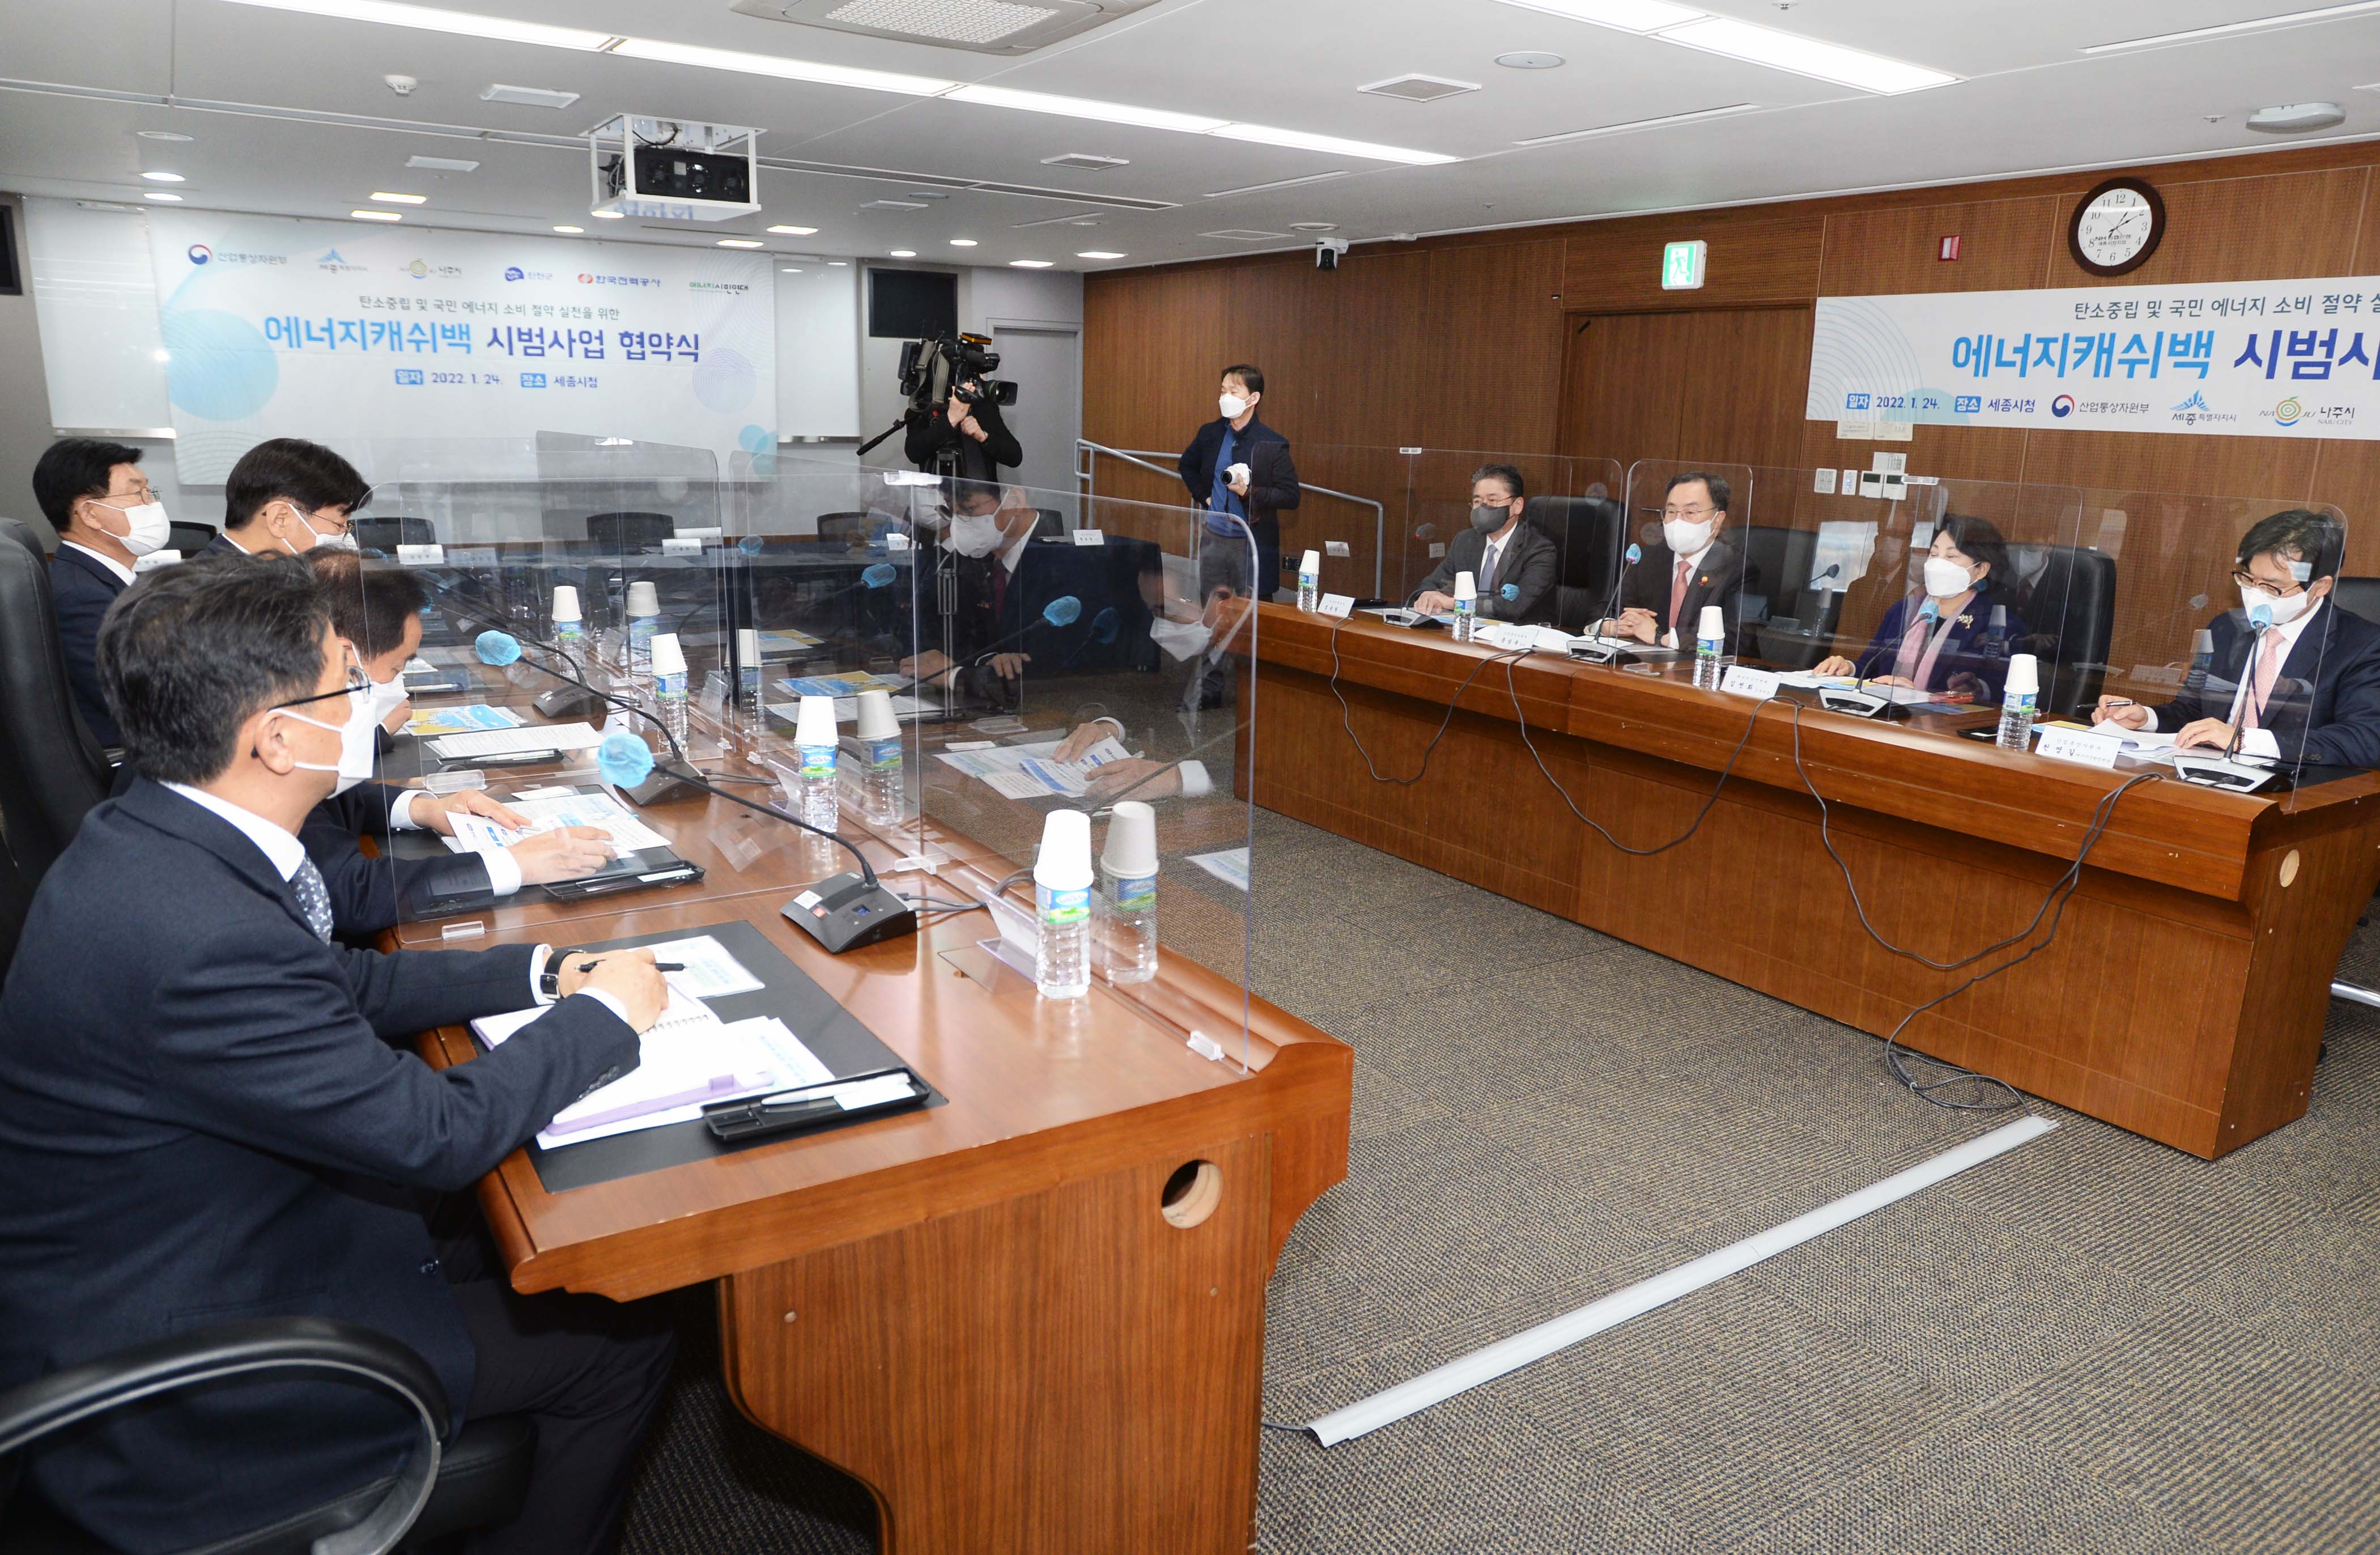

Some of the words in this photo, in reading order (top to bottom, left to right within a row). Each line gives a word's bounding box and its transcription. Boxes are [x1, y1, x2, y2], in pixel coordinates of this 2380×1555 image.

[2102, 199, 2110, 207] 11
[2115, 194, 2126, 203] 12
[2131, 197, 2136, 207] 1
[2086, 225, 2092, 235] 9
[2141, 222, 2148, 231] 3
[2088, 238, 2095, 248] 8
[2135, 236, 2141, 245] 4
[2096, 249, 2102, 258] 7
[2110, 252, 2116, 262] 6
[2124, 248, 2131, 257] 5
[596, 275, 661, 287] 한국전력공사
[359, 296, 410, 311] 탄소중립
[416, 298, 428, 311] 및
[434, 299, 457, 313] 국민
[462, 301, 497, 314] 에너지
[503, 303, 526, 316] 소비
[532, 304, 554, 317] 절약
[559, 307, 592, 320] 실천을
[598, 308, 619, 321] 위한
[2075, 300, 2139, 320] 탄소중립
[2147, 300, 2161, 318] 및
[2169, 299, 2203, 318] 국민
[2211, 296, 2266, 317] 에너지
[2273, 295, 2312, 315] 소비
[2322, 292, 2363, 314] 절약
[265, 316, 471, 354] 에너지캐쉬백
[487, 325, 605, 360] 시범사업
[618, 330, 699, 363] 협약식
[1952, 330, 2215, 379] 에너지캐쉬백
[484, 374, 503, 385] 24.
[521, 373, 545, 387] 장소
[554, 375, 598, 389] 세종시청
[1847, 394, 1869, 409] 일자
[1876, 396, 1906, 409] 2022.
[1911, 397, 1918, 409] 1.
[1923, 397, 1940, 410] 24.
[1956, 397, 1980, 412] 장소
[1987, 398, 2035, 413] 세종시청
[2079, 401, 2149, 414] 산업통상자원부
[2320, 406, 2355, 419] 나주시
[2171, 413, 2197, 426] 세종
[2199, 413, 2237, 422] 특별자치시
